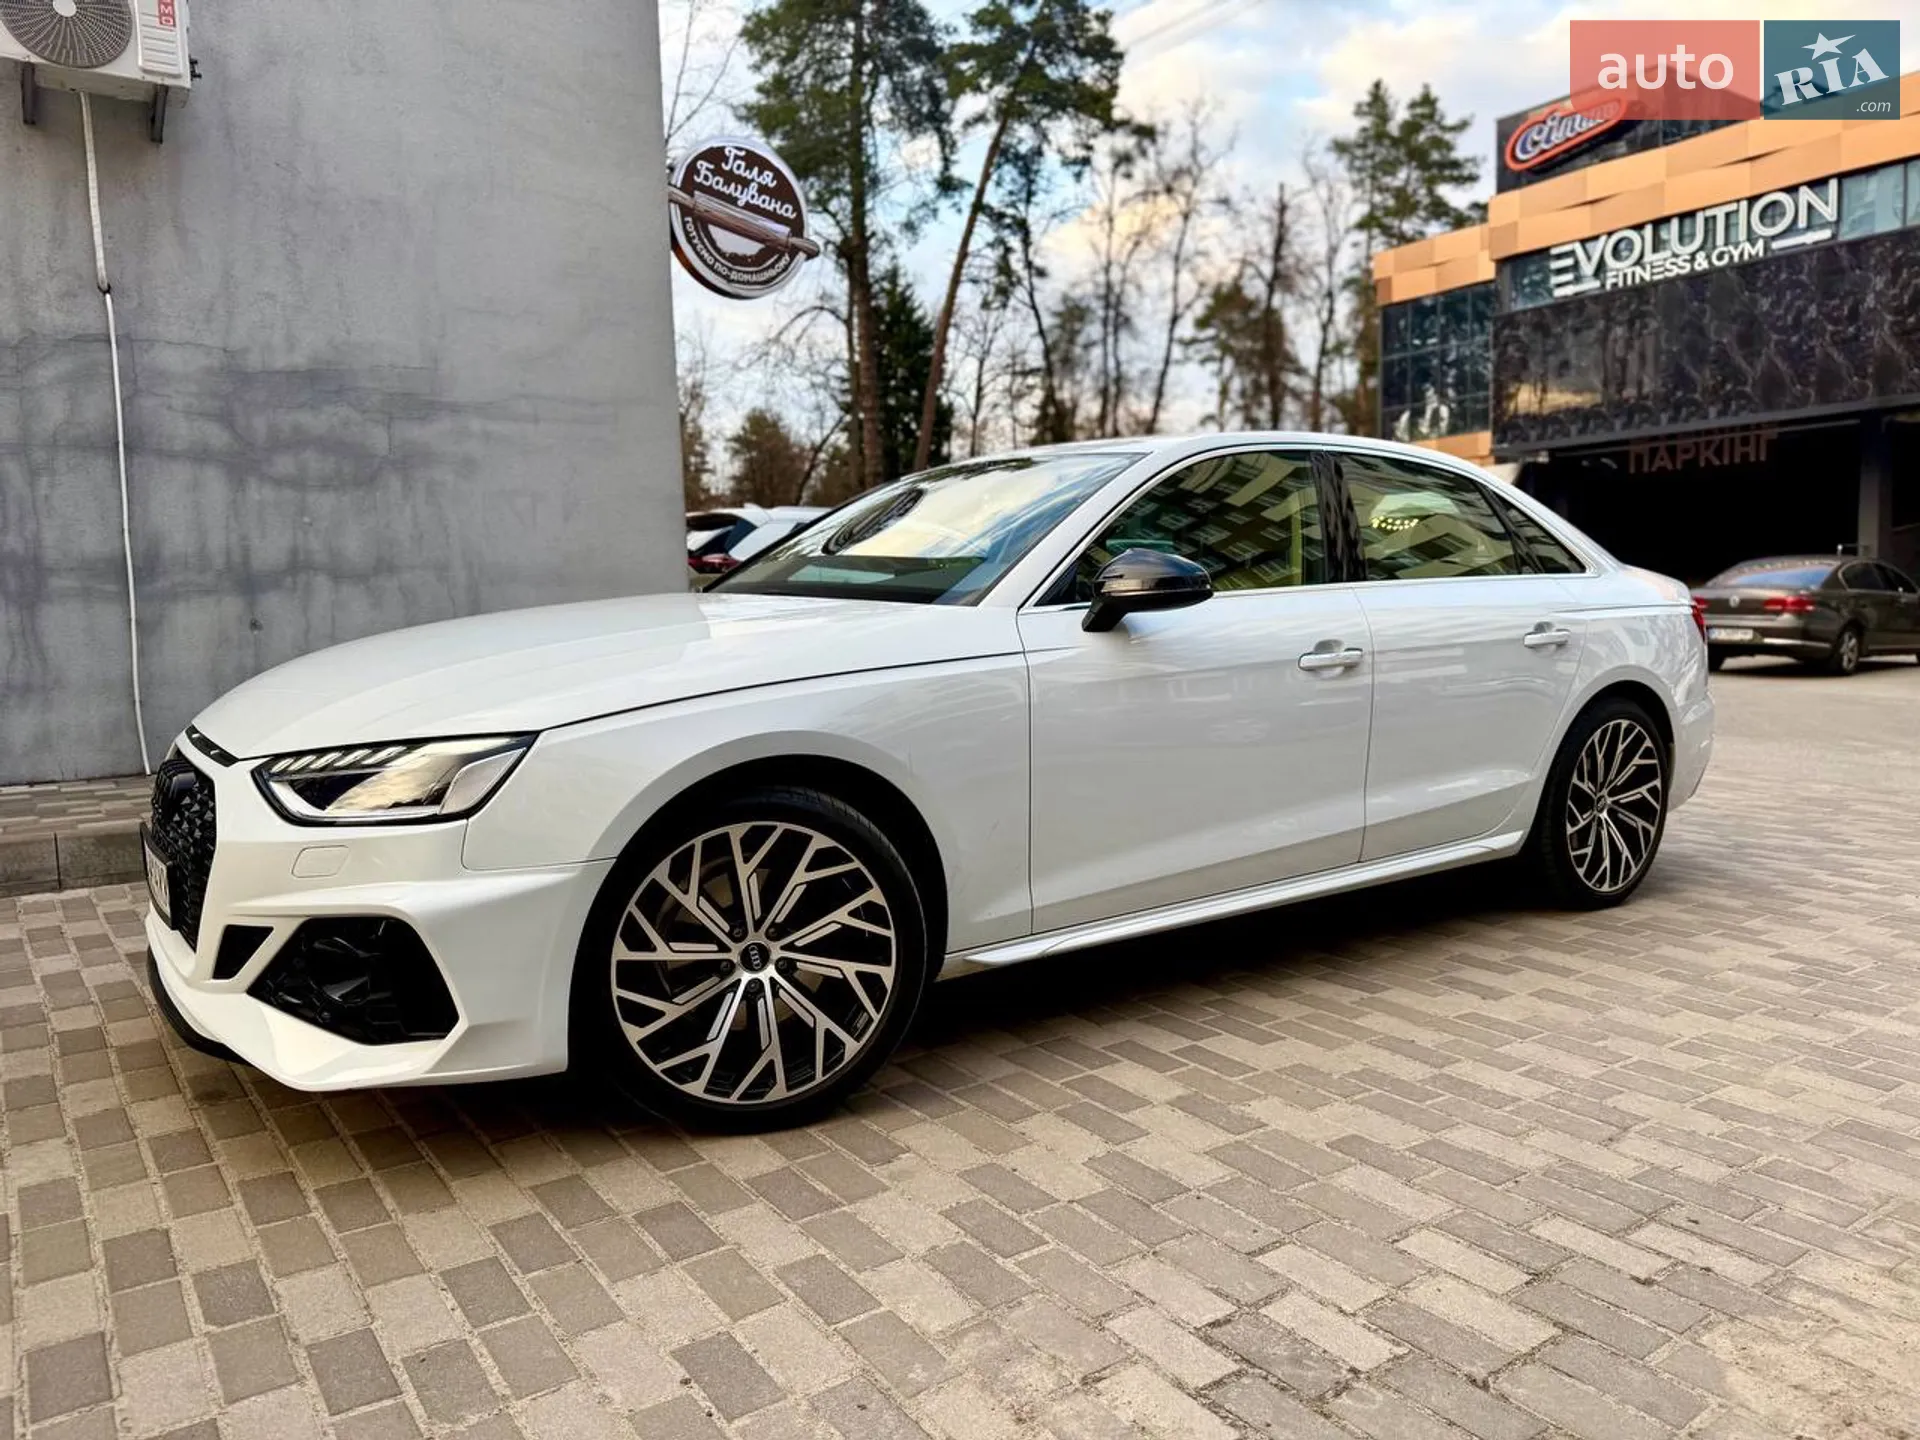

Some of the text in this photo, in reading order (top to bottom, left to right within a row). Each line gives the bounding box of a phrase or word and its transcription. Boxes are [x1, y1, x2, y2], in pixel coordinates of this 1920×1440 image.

[693, 160, 798, 220] Балувана
[721, 146, 777, 187] Галя
[1549, 178, 1839, 295] EVOLUTION
[1605, 239, 1766, 291] FITNESS & GYM
[1628, 431, 1778, 475] ПАРКІНГ
